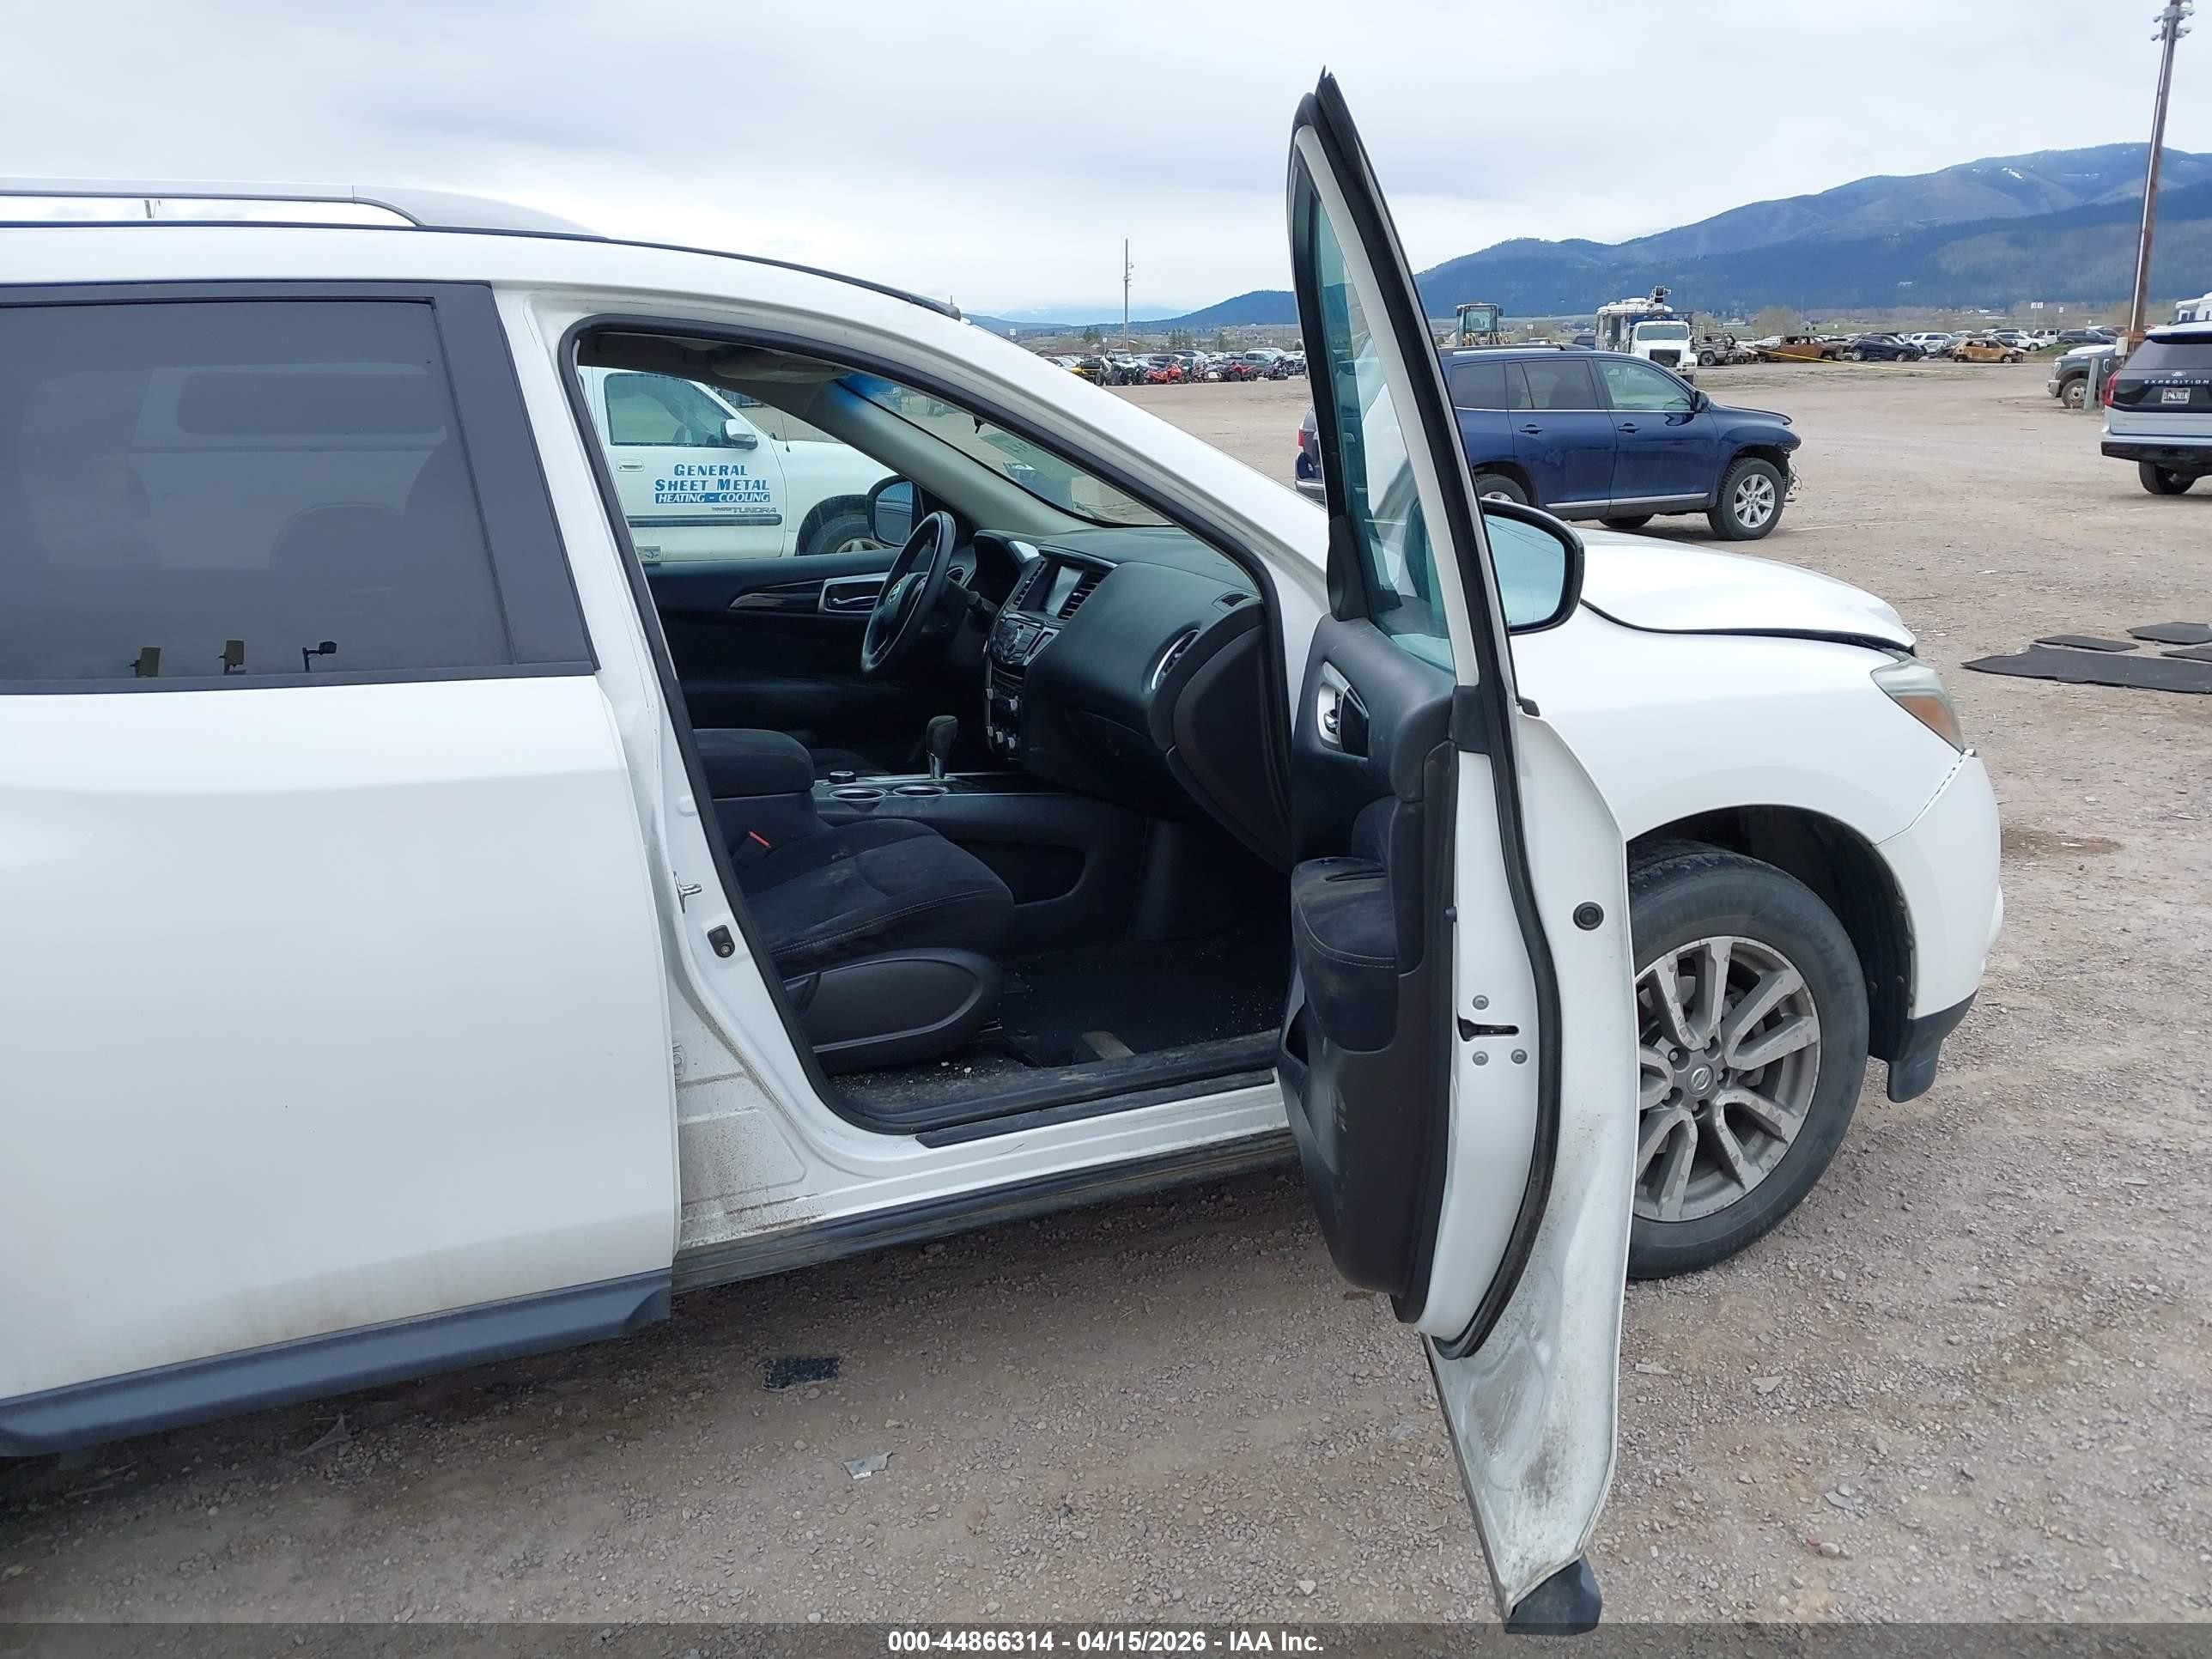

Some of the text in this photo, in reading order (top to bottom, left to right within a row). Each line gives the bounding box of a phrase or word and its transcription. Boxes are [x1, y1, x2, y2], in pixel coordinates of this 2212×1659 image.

[673, 464, 748, 477] GENERAL
[654, 478, 770, 491] SHEET METAL
[658, 493, 706, 503] HEATING
[718, 493, 770, 503] COOLING
